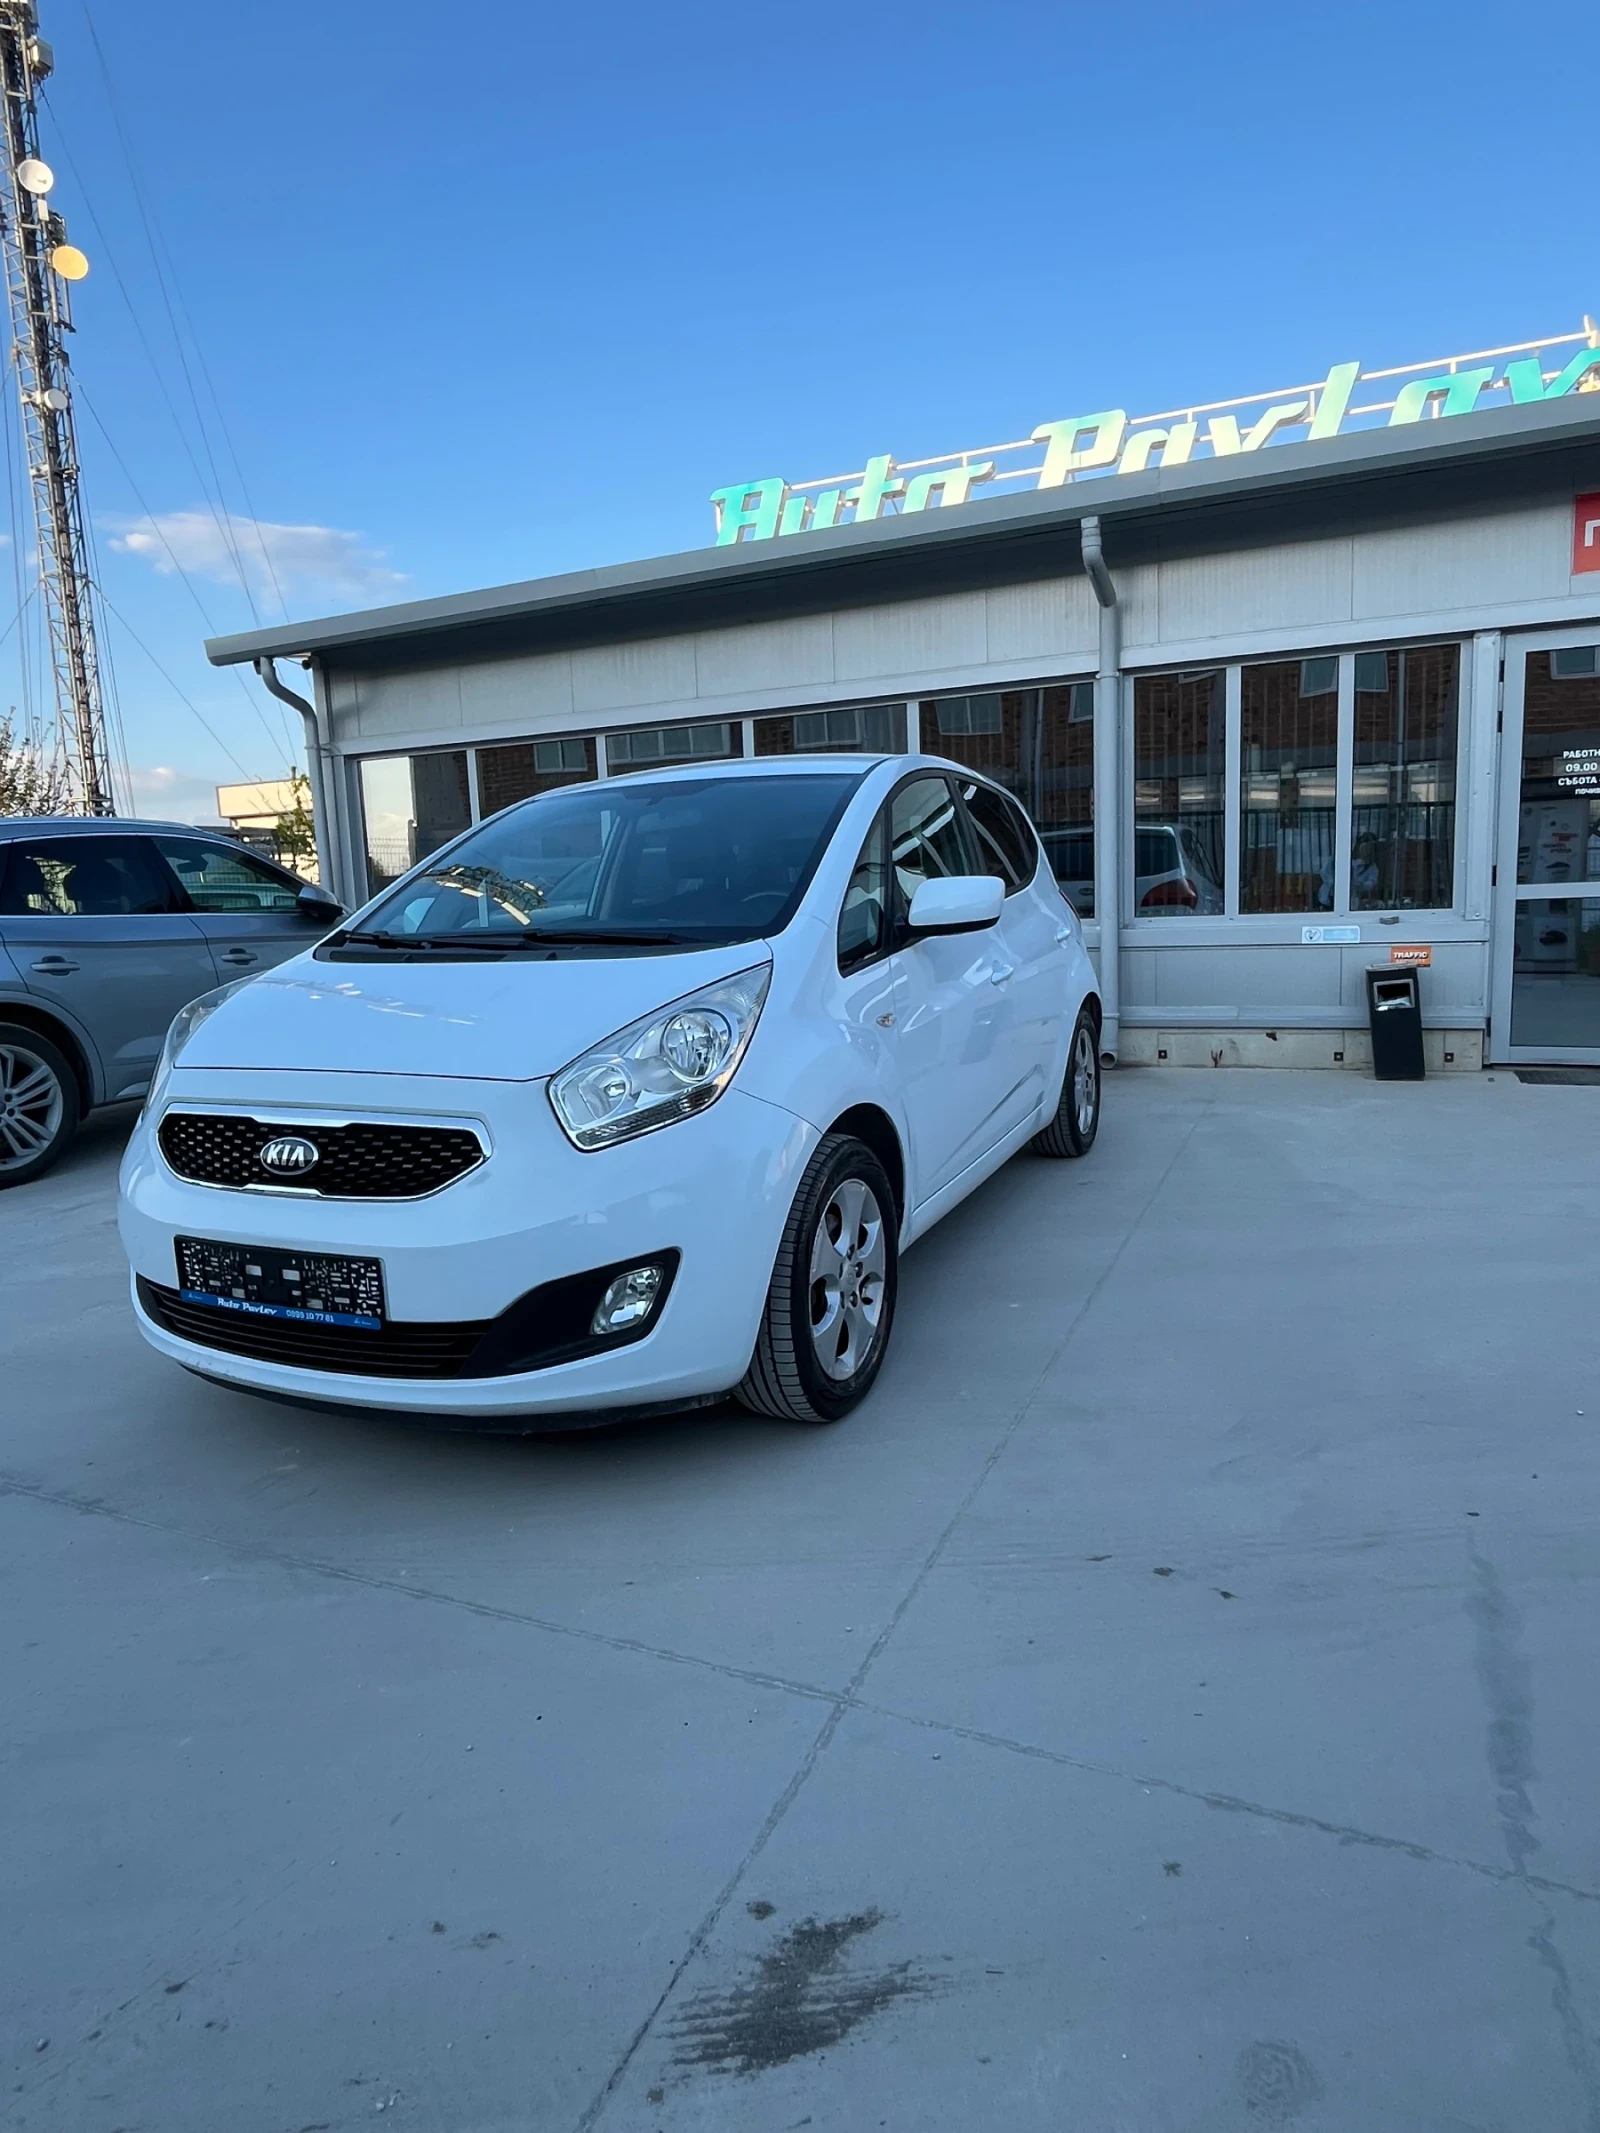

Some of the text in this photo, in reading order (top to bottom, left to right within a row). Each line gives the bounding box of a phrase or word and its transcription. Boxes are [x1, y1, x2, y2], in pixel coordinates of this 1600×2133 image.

[708, 454, 995, 546] Auto
[1565, 762, 1598, 772] 09.00
[1558, 776, 1598, 786] СЪБОТА
[1393, 951, 1428, 959] TRAFFIC
[266, 1144, 305, 1167] KIA
